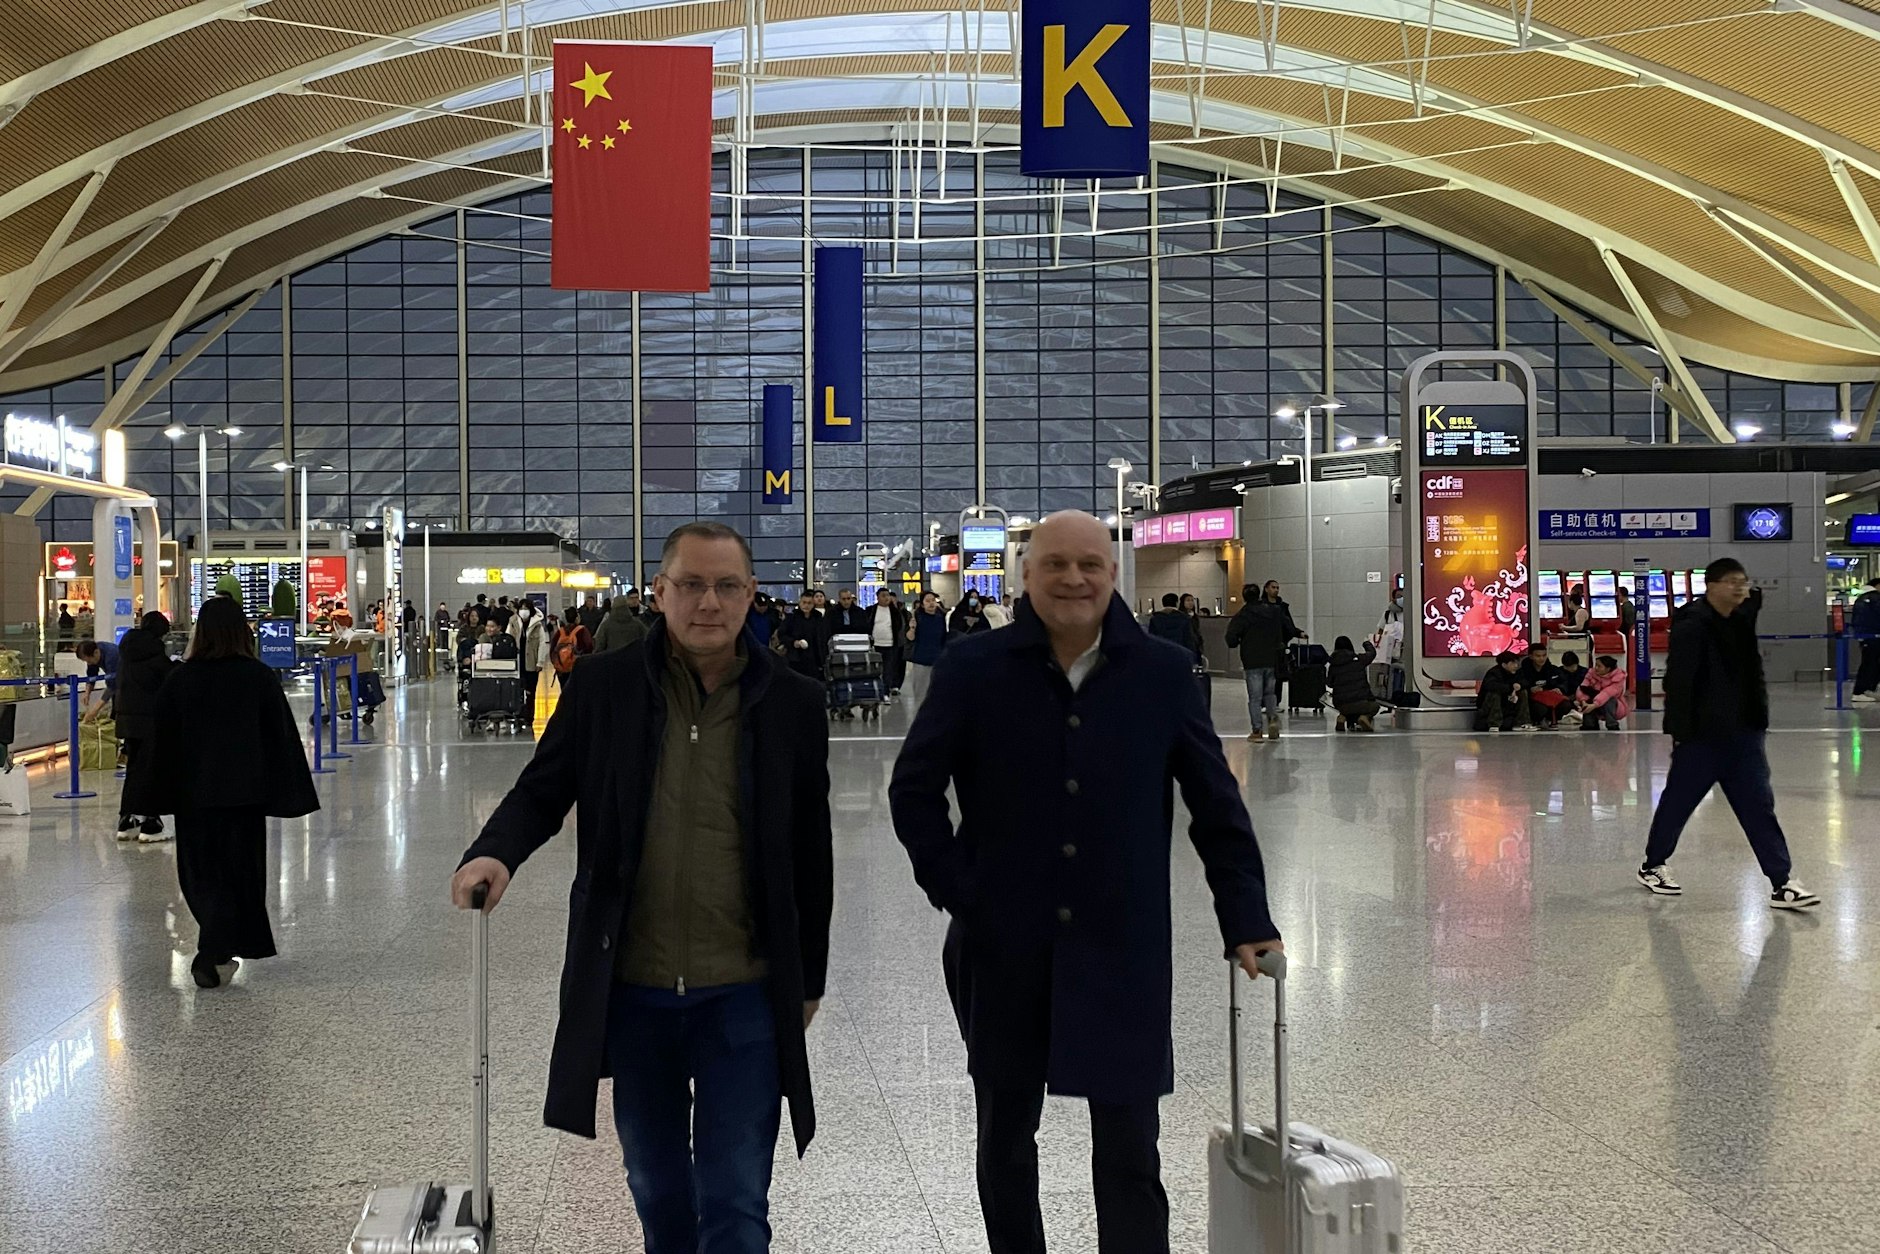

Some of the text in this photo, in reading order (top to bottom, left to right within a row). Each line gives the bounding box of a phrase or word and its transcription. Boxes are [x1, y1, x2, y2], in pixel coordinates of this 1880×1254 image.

[1043, 24, 1134, 128] K
[825, 386, 852, 426] L
[1425, 406, 1446, 430] K
[765, 470, 790, 495] M
[1426, 475, 1453, 489] cdf
[1550, 513, 1616, 528] 自助值机
[262, 645, 292, 653] Entrance
[1637, 622, 1646, 663] Economy
